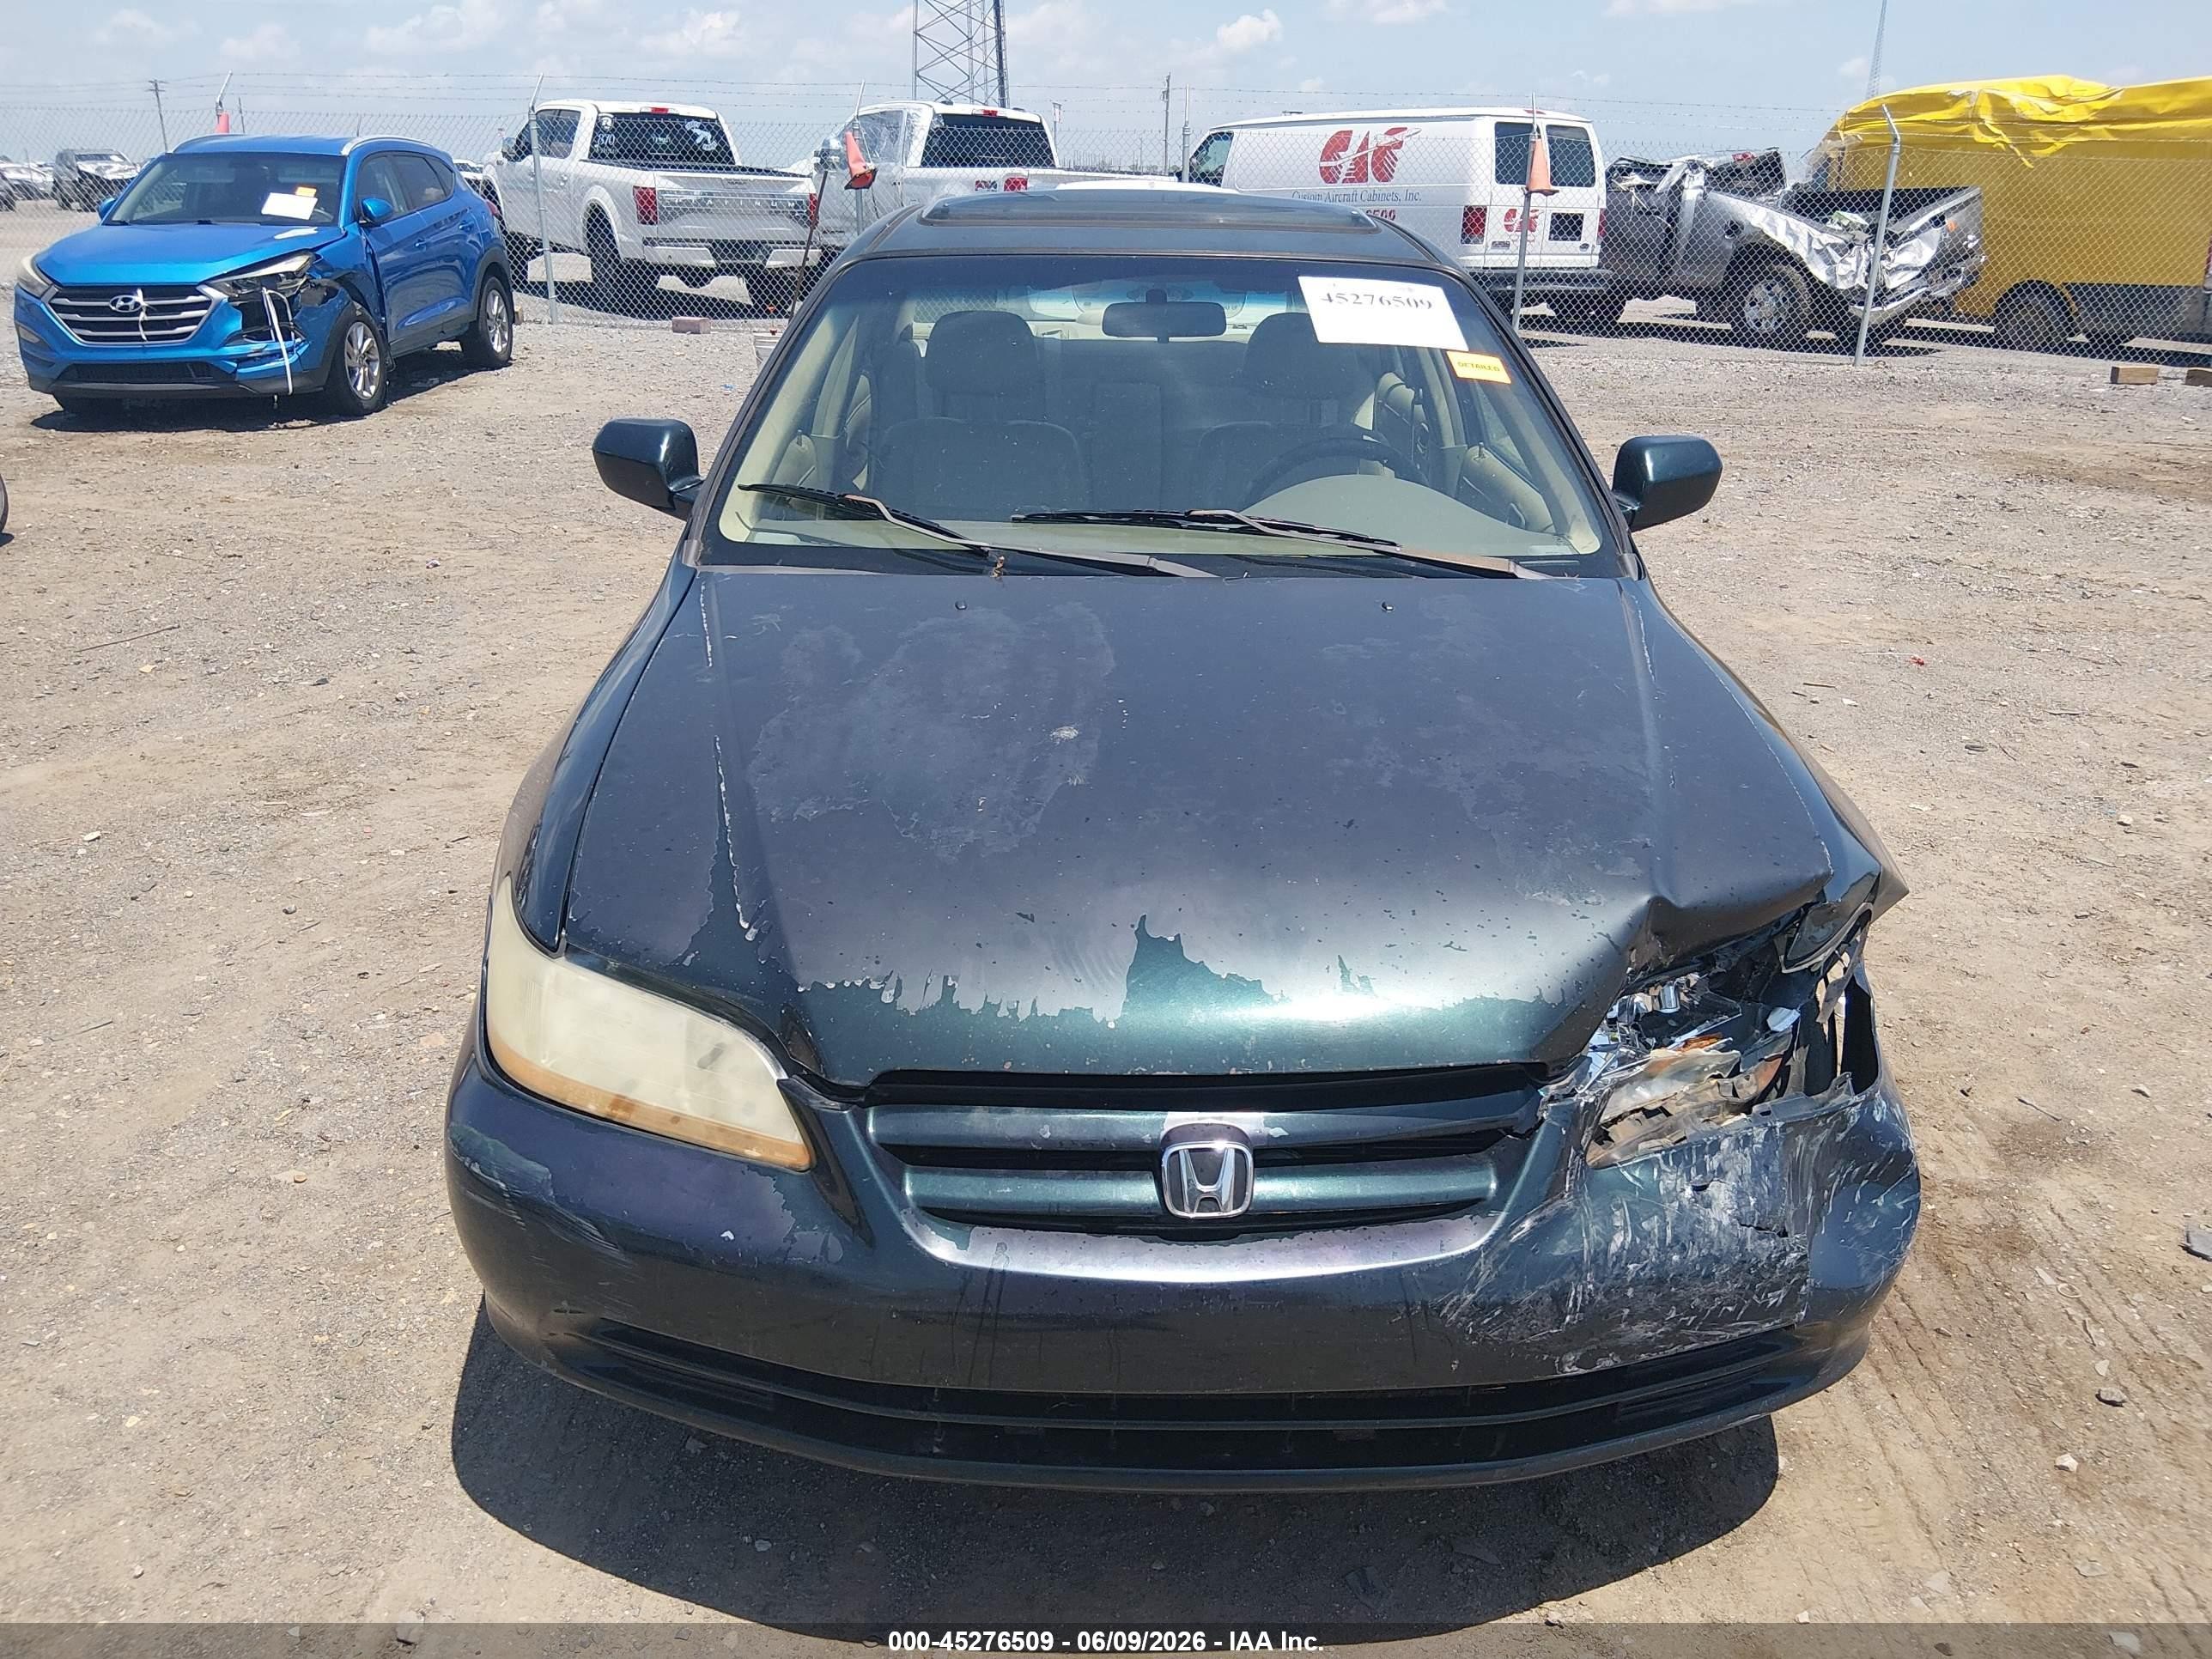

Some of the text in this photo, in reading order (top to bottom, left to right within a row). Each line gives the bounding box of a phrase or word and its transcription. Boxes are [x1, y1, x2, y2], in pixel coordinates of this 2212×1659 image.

[1324, 189, 1358, 203] Aircraft
[1360, 190, 1401, 204] Cabinets,
[1405, 189, 1421, 202] Inc.
[1321, 292, 1432, 310] 45276509
